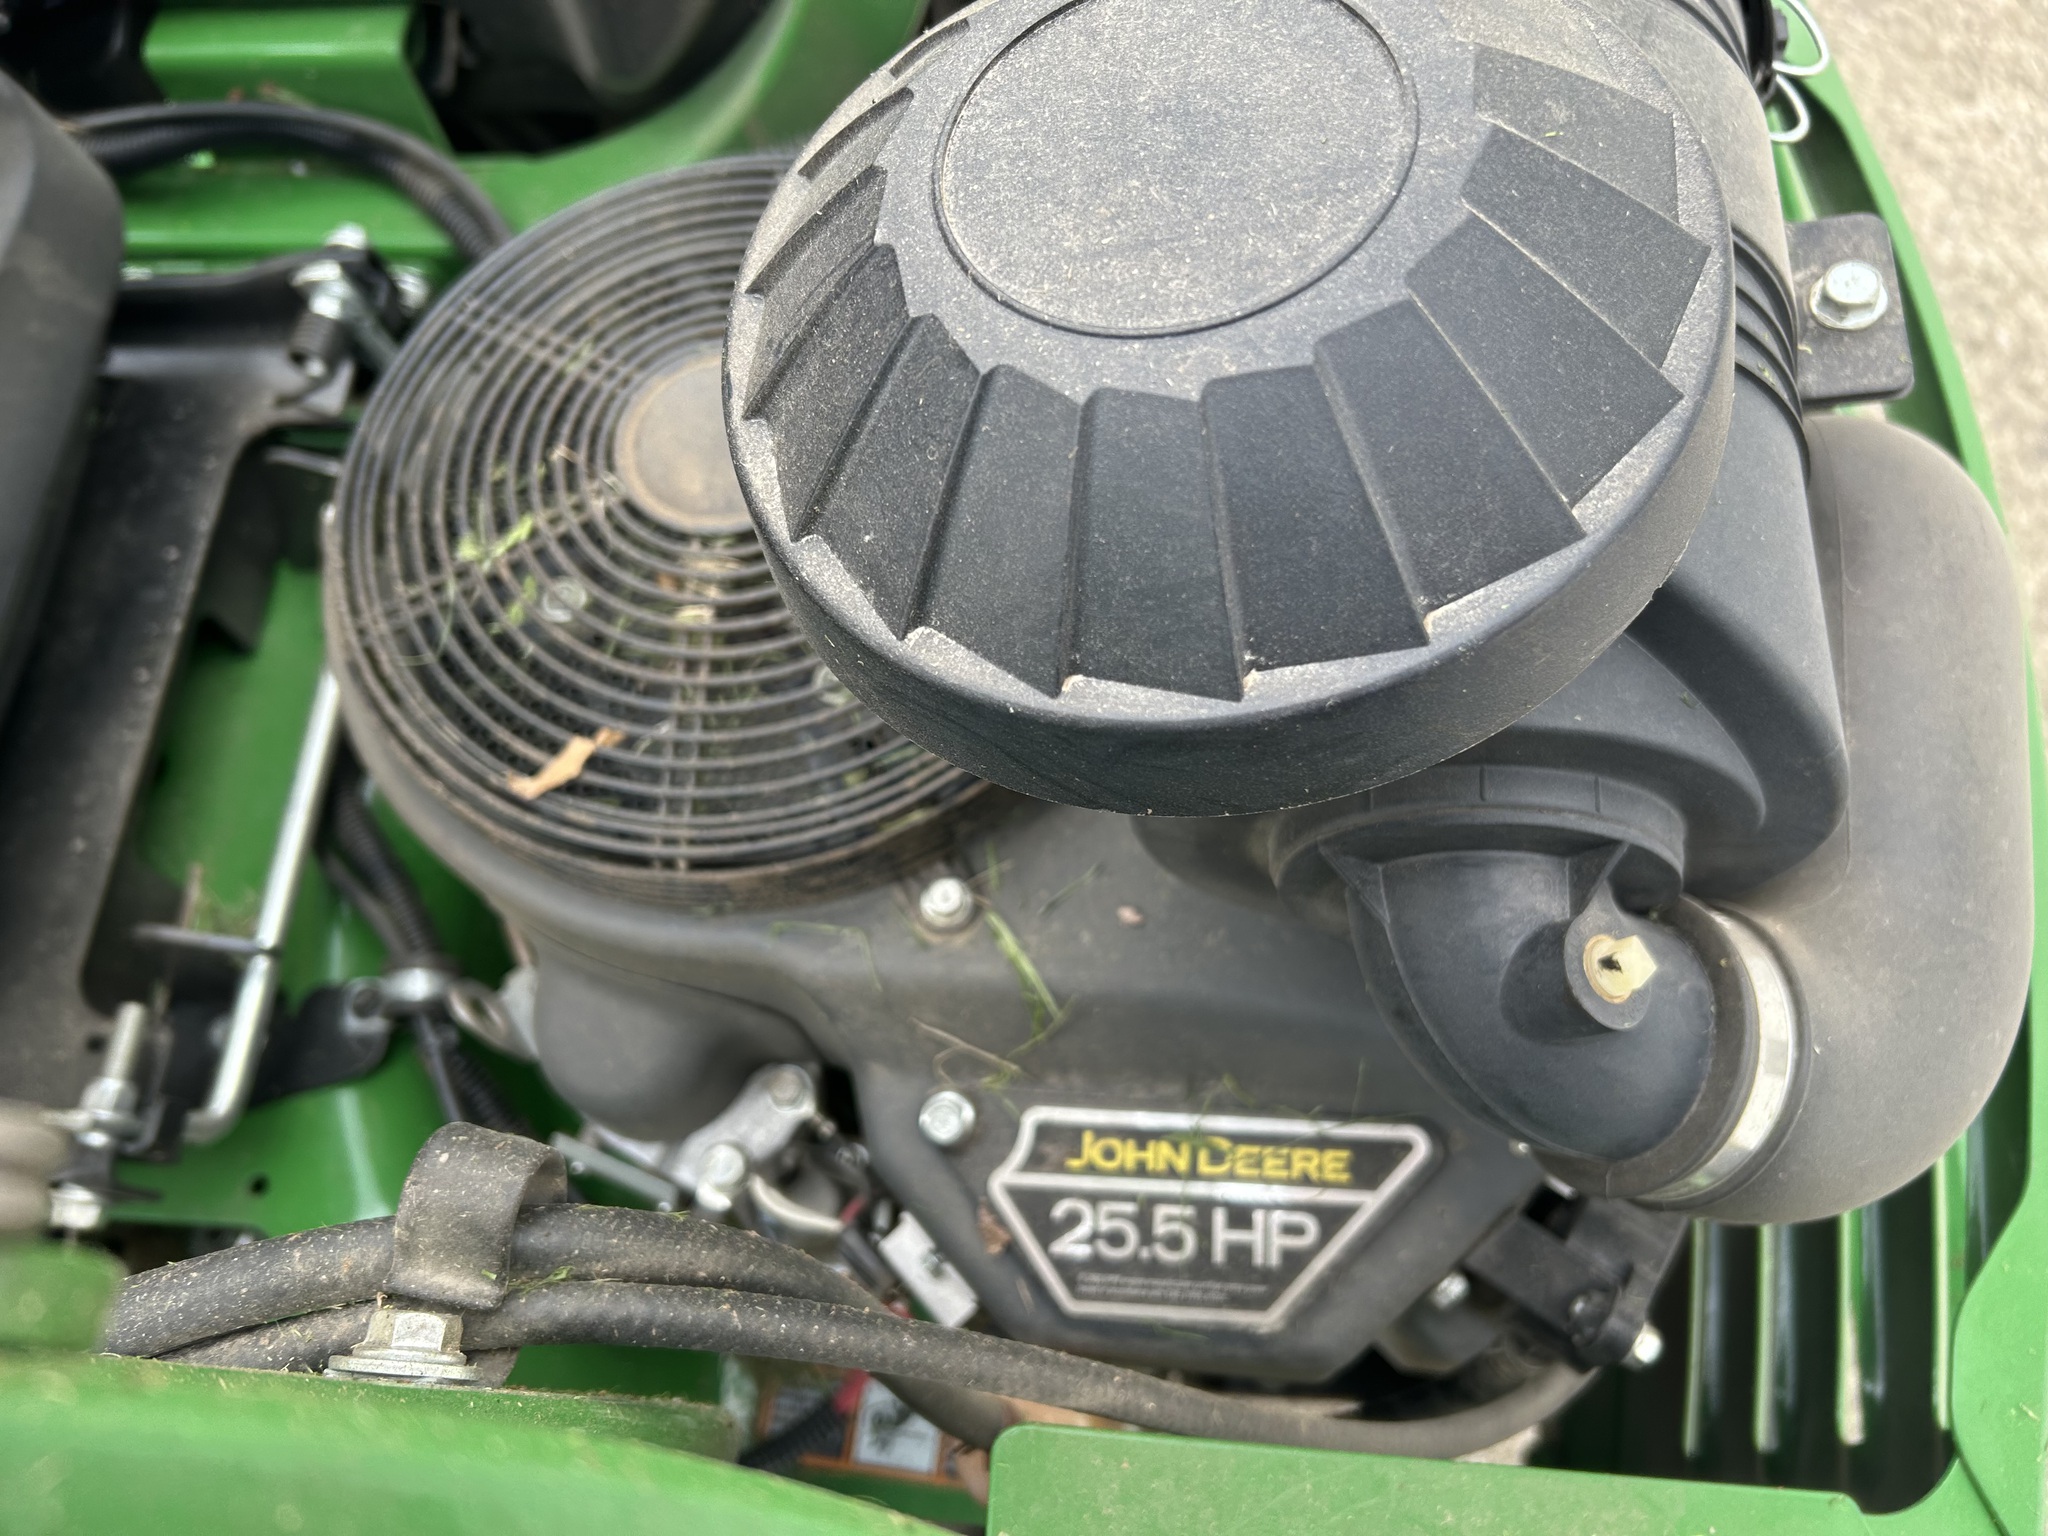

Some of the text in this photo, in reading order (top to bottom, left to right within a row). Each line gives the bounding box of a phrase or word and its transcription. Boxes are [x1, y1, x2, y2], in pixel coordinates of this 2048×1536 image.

[1064, 1129, 1354, 1184] JOHN DEERE
[1048, 1197, 1321, 1269] 25.5 HP
